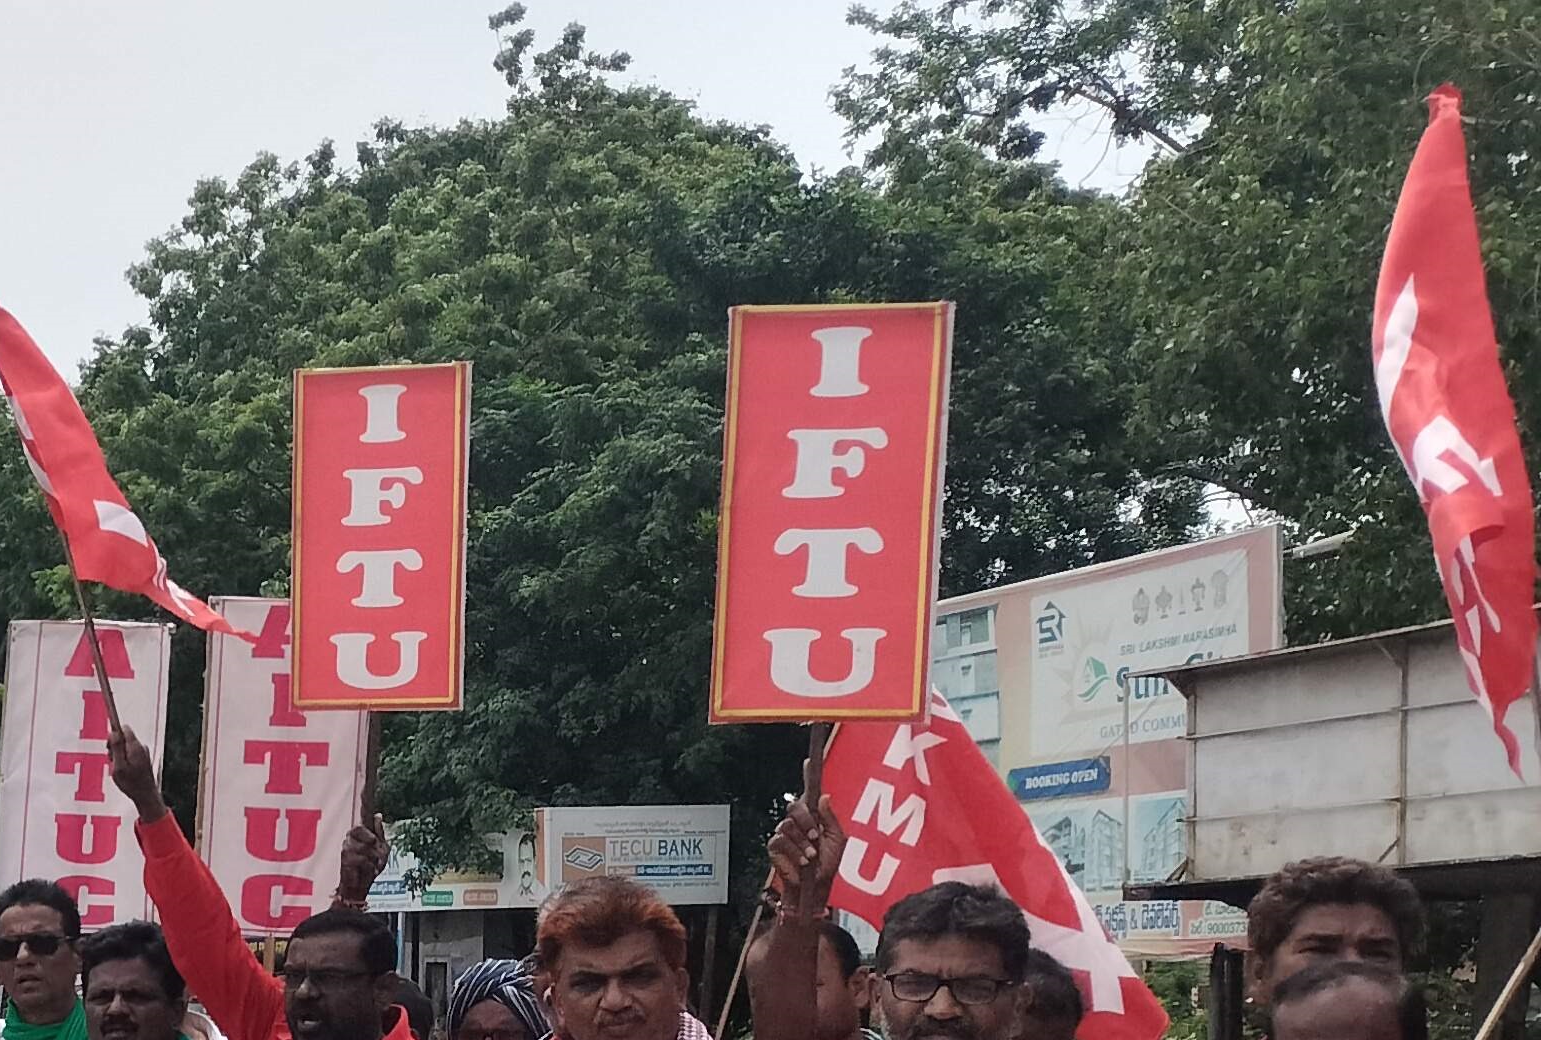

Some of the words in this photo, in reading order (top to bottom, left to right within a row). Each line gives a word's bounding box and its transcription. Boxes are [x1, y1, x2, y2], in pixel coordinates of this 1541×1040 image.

[763, 326, 888, 697] IFTU
[330, 384, 427, 690] IFTU
[1100, 720, 1139, 738] GATD
[1025, 771, 1070, 790] BOOKING
[1071, 767, 1098, 785] OPEN
[609, 839, 652, 856] TECU
[658, 838, 703, 856] BANK
